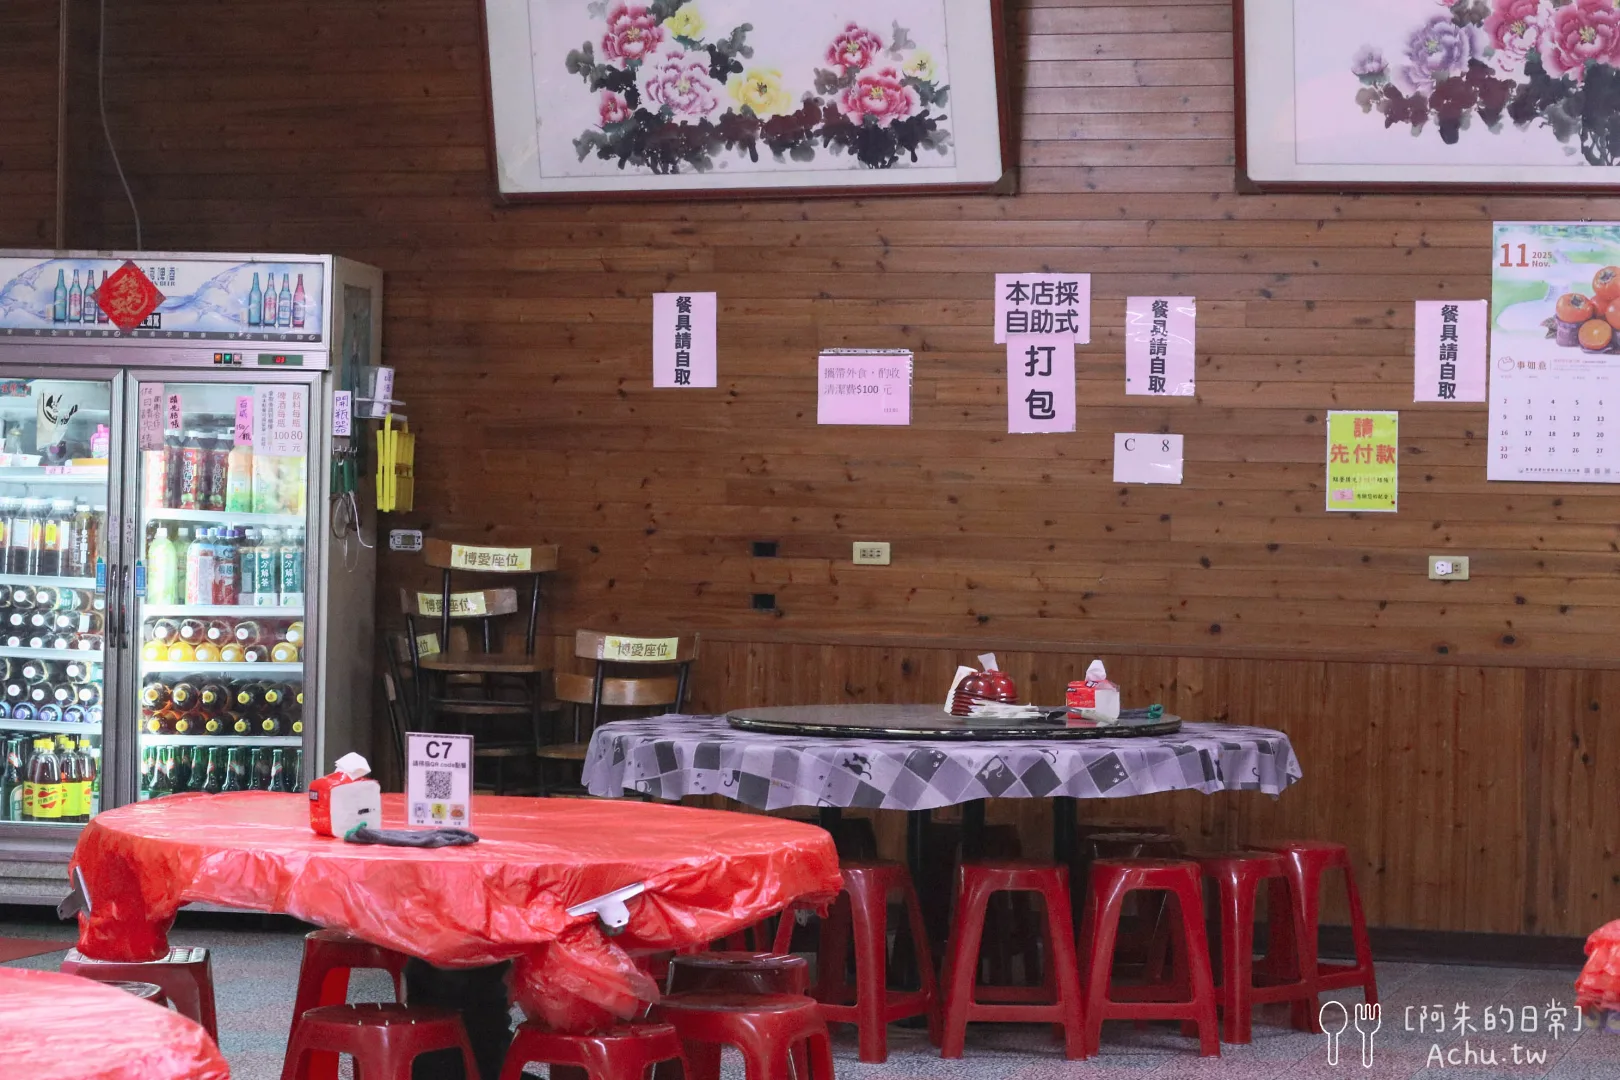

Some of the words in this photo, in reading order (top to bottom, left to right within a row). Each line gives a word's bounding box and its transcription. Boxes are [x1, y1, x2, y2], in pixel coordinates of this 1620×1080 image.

[1499, 243, 1530, 267] 11
[1531, 260, 1551, 268] Nov.
[1532, 251, 1553, 259] 2025
[1005, 280, 1080, 306] 本店採
[1005, 308, 1079, 334] 自助式
[673, 295, 693, 386] 餐具請自取
[1147, 299, 1169, 393] 餐具請自取
[1437, 303, 1460, 400] 餐具請自取
[883, 384, 893, 396] 元
[1024, 344, 1056, 420] 打包
[1353, 417, 1374, 439] 請
[1124, 438, 1136, 452] C
[1161, 439, 1170, 453] 8
[1330, 443, 1396, 465] 先付款
[464, 551, 519, 567] 博愛座位
[260, 560, 269, 587] 分解茶
[284, 560, 293, 587] 分解茶
[424, 597, 471, 613] 博愛座位
[617, 641, 668, 658] 博愛座位
[426, 740, 453, 759] C7
